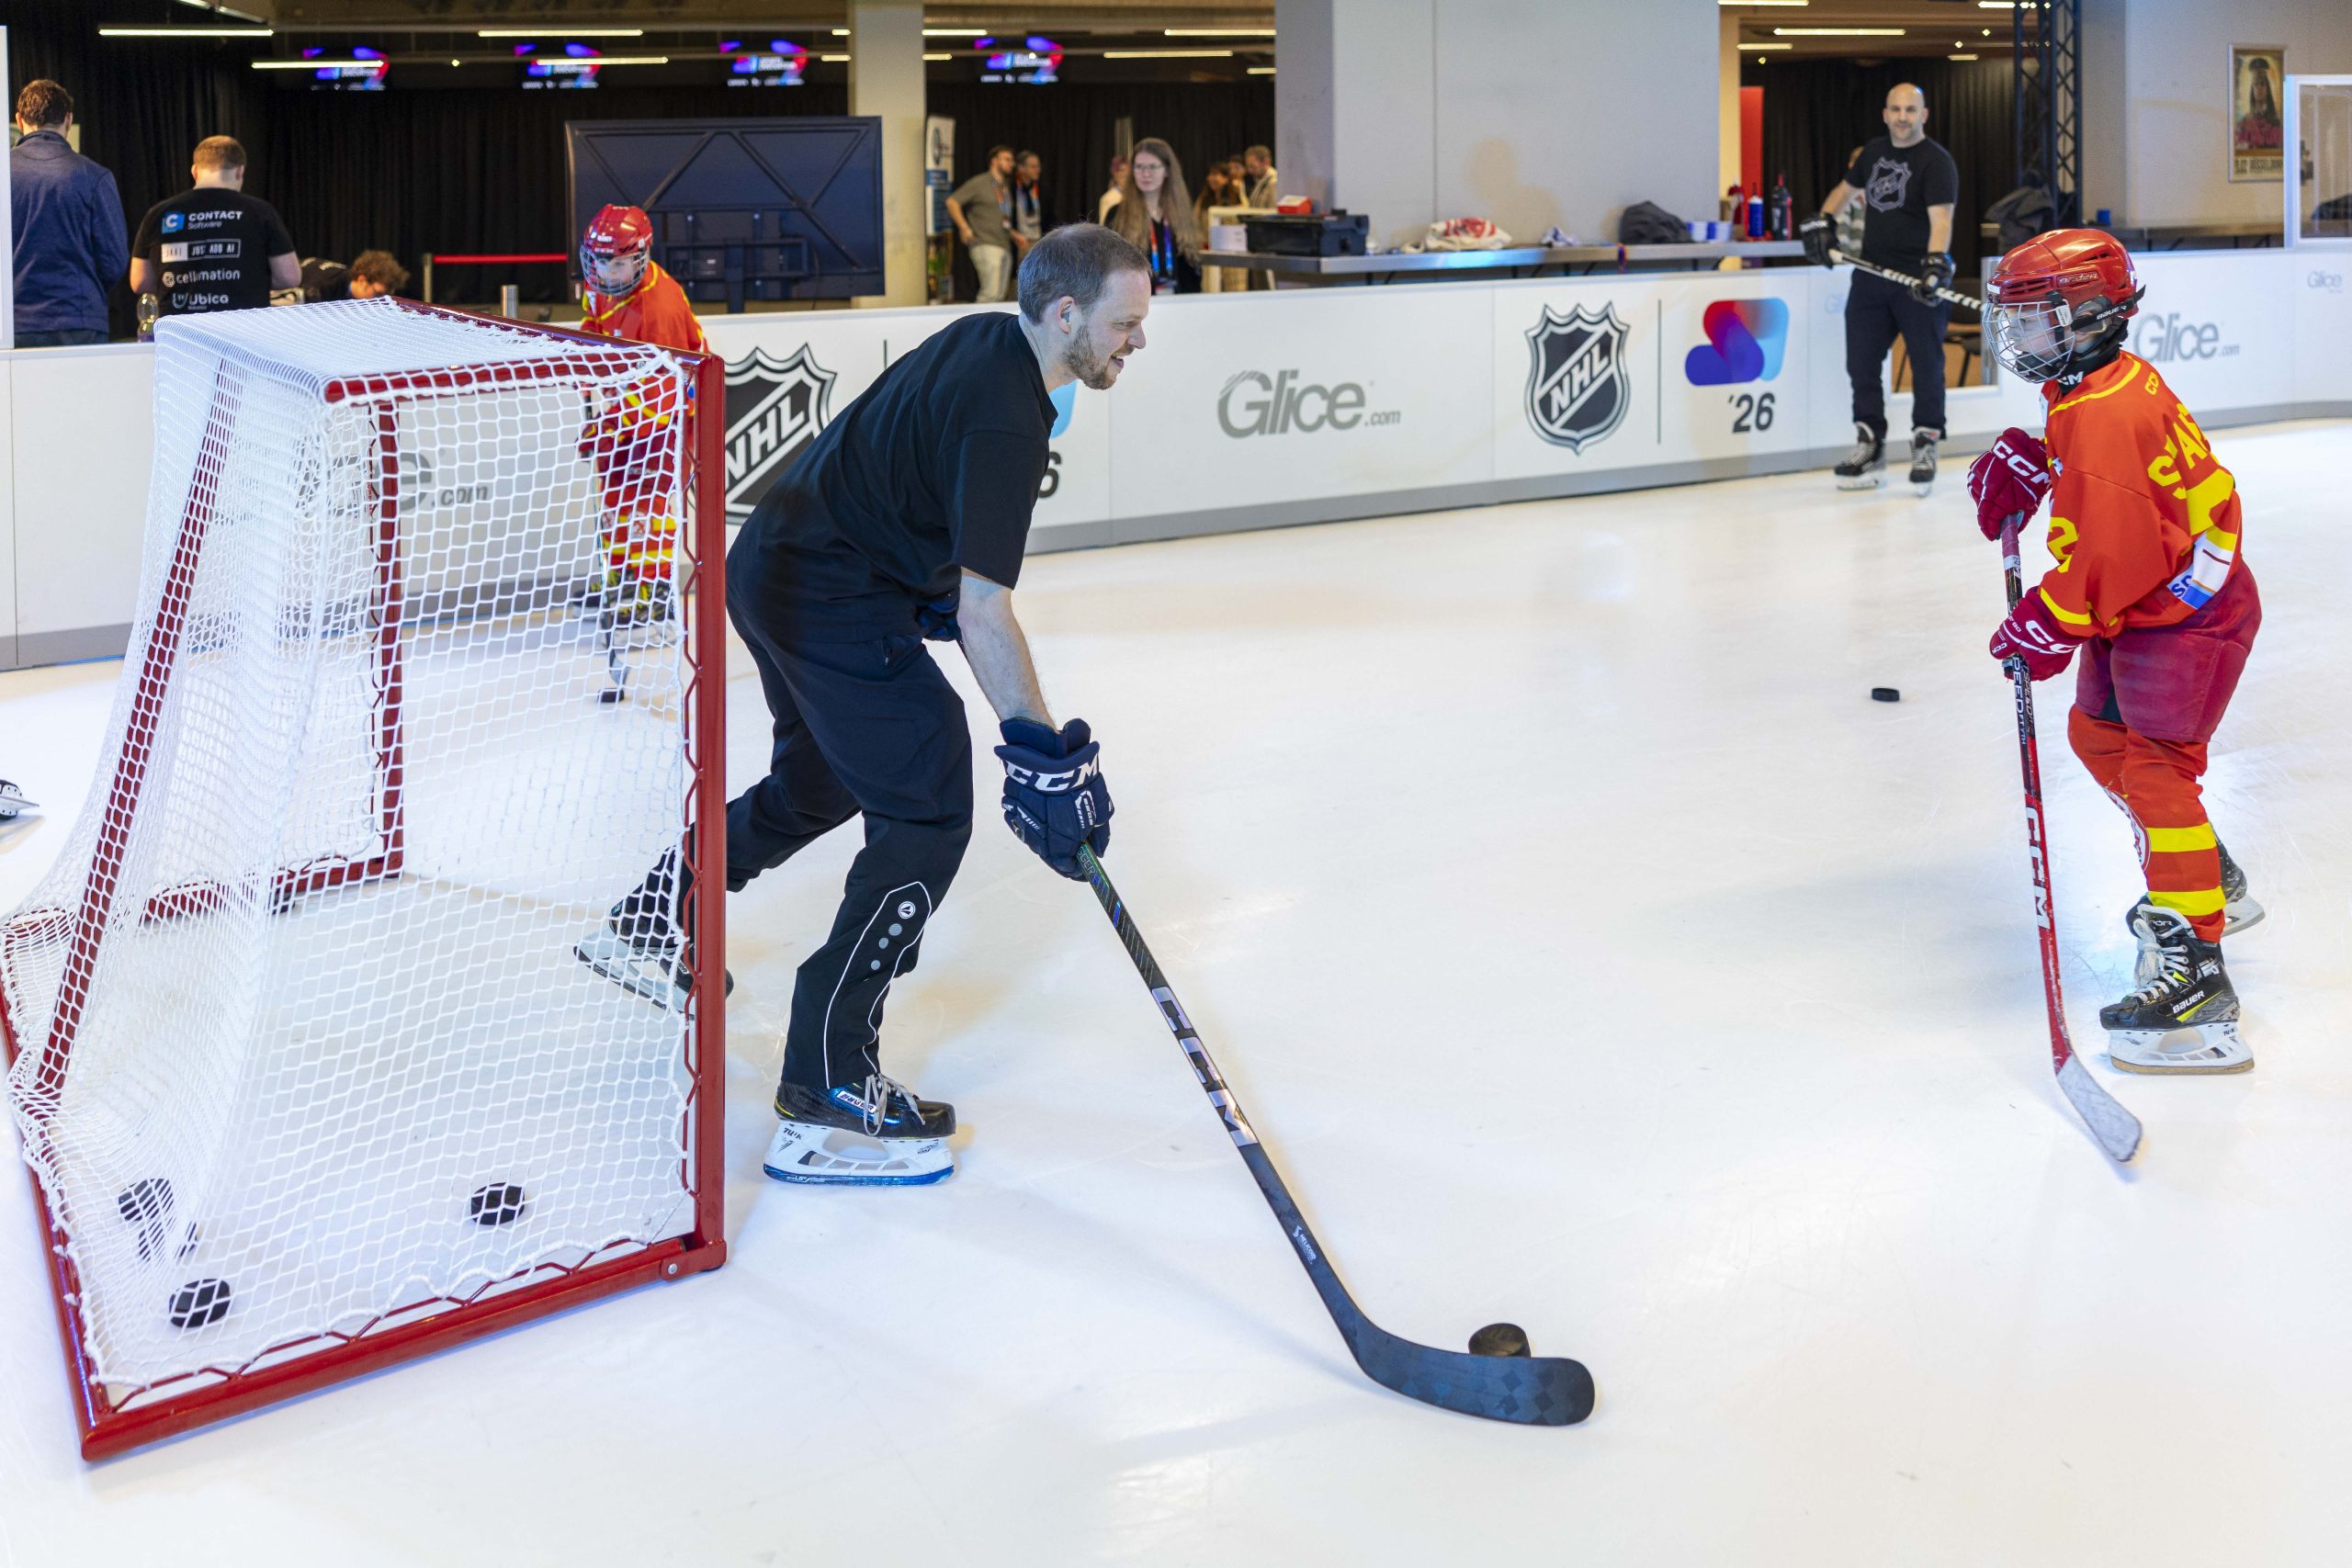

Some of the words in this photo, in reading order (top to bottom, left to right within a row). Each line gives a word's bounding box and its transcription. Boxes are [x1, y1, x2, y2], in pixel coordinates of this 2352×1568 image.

[187, 220, 222, 231] Software
[188, 210, 243, 222] CONTACT
[191, 244, 206, 256] JUS
[175, 267, 241, 285] cellmation
[1550, 344, 1610, 423] NHL
[2058, 370, 2084, 386] CM
[2144, 371, 2159, 395] CC
[1726, 391, 1776, 434] '26
[725, 394, 805, 492] NHL
[1005, 751, 1099, 792] CCM
[2025, 806, 2051, 930] CCM
[1151, 986, 1259, 1146] CCM
